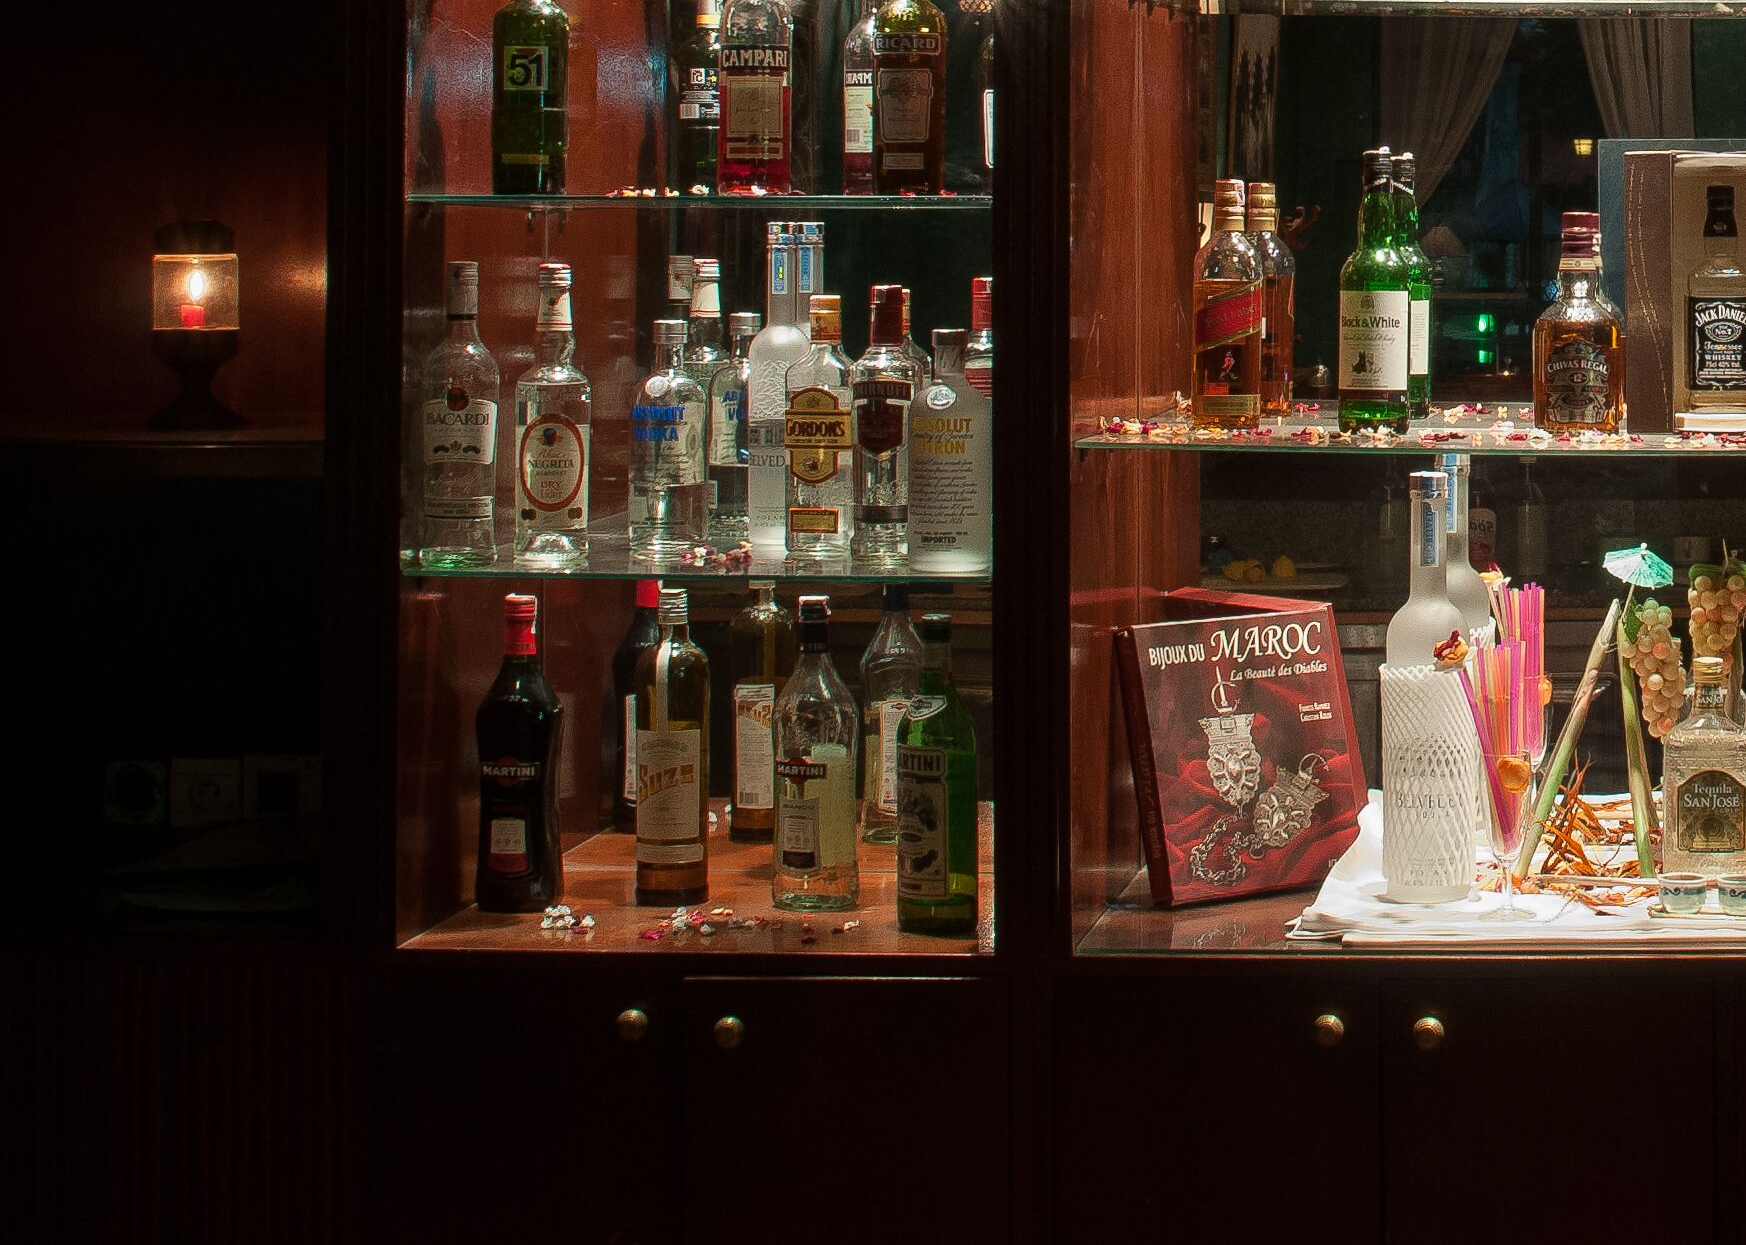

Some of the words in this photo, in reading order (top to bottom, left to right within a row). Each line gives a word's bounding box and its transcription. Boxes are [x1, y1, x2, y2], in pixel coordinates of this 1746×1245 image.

[875, 36, 937, 50] RICARD
[721, 48, 789, 68] CAMPARI
[507, 56, 546, 87] 51
[1694, 307, 1718, 327] JACK
[1546, 359, 1579, 373] CHIVAS
[1580, 359, 1608, 374] REGAL
[1573, 373, 1582, 382] 12
[426, 412, 490, 426] BACARDI
[786, 417, 846, 438] GORDON'S
[529, 459, 575, 469] NEGRITA
[540, 481, 562, 490] DRY
[920, 535, 957, 544] IMPORTED
[1148, 643, 1187, 670] BIJOUX
[1188, 642, 1206, 663] DU
[1210, 620, 1322, 663] MAROC
[1230, 669, 1243, 681] La
[1244, 666, 1277, 680] Beauté
[1278, 665, 1292, 677] des
[1293, 659, 1328, 674] Diables
[482, 764, 536, 777] MARTINI
[778, 763, 825, 776] MARTINI
[1691, 781, 1732, 798] Tequila
[1683, 793, 1711, 808] SAN
[1711, 792, 1740, 810] JOSÉ
